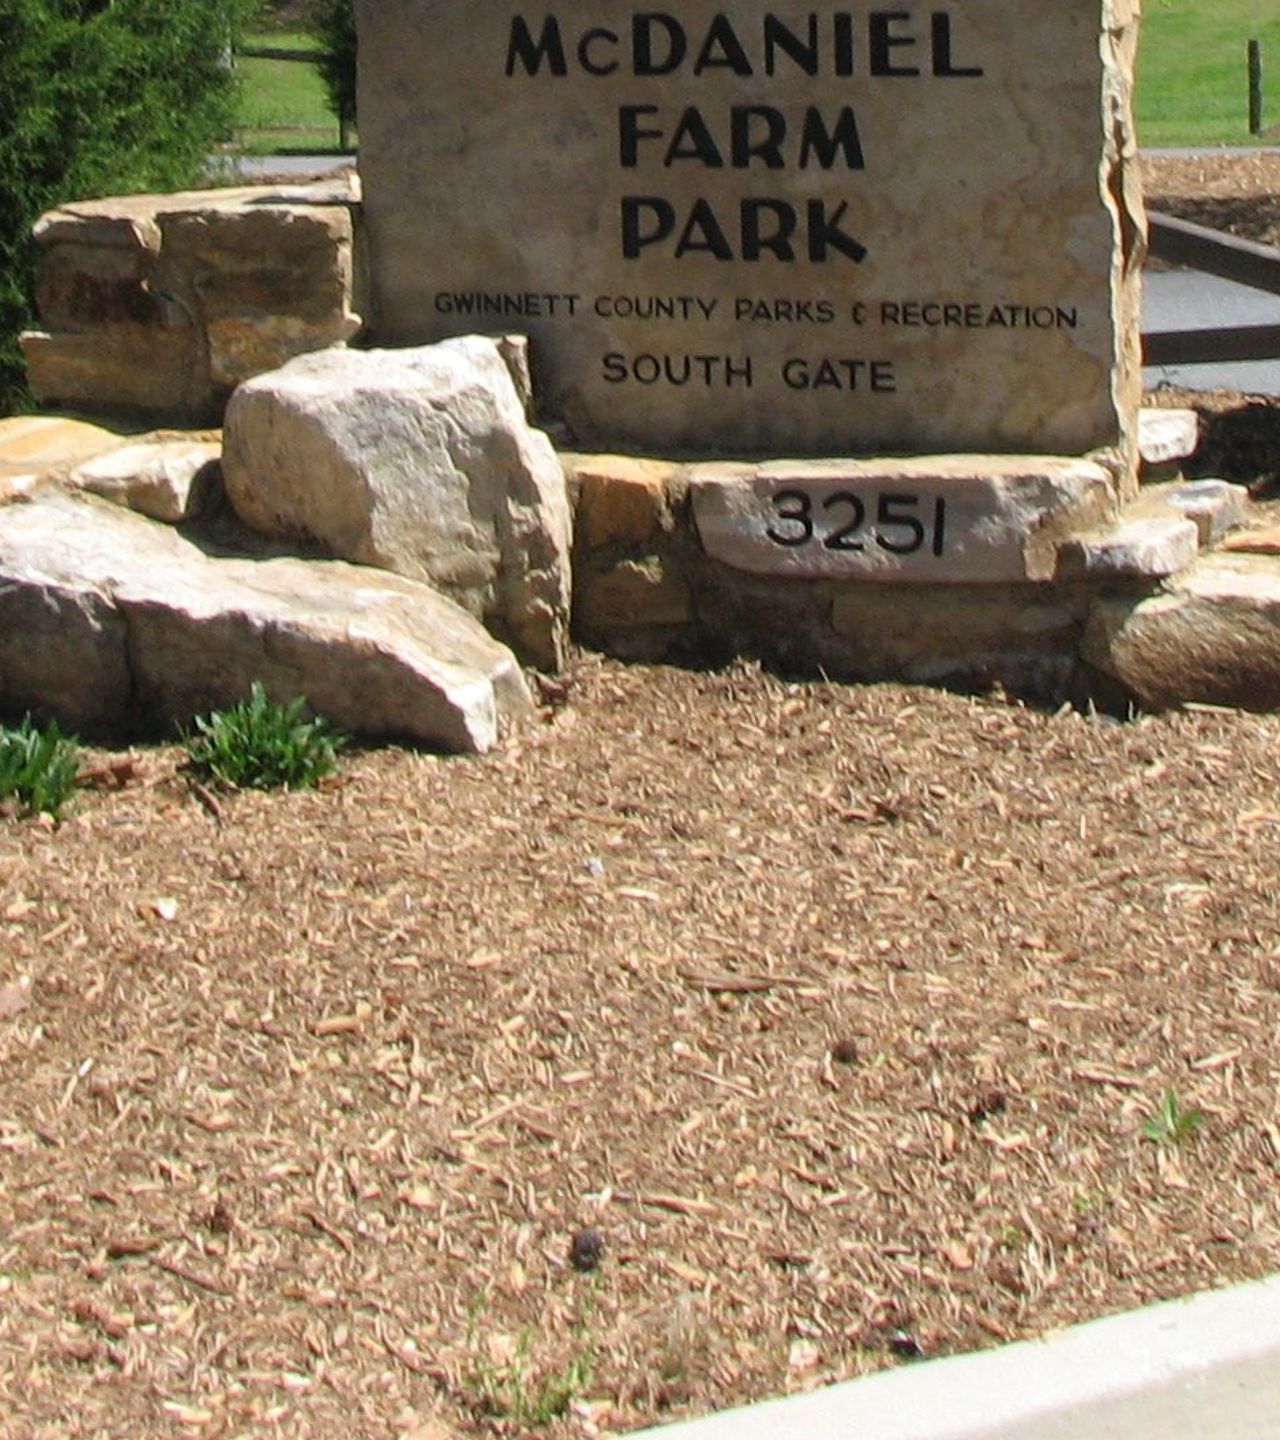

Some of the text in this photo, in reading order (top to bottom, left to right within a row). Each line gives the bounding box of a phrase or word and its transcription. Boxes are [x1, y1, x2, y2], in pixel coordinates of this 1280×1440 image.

[504, 12, 984, 79] McDANIEL
[619, 105, 866, 171] FARM
[620, 195, 868, 264] PARK
[434, 291, 581, 319] GWINNETT
[594, 293, 717, 322] COUNTY
[734, 298, 836, 324] PARKS
[879, 300, 1079, 330] RECREATION
[602, 352, 898, 393] SOUTH GATE
[765, 489, 946, 558] 3251
